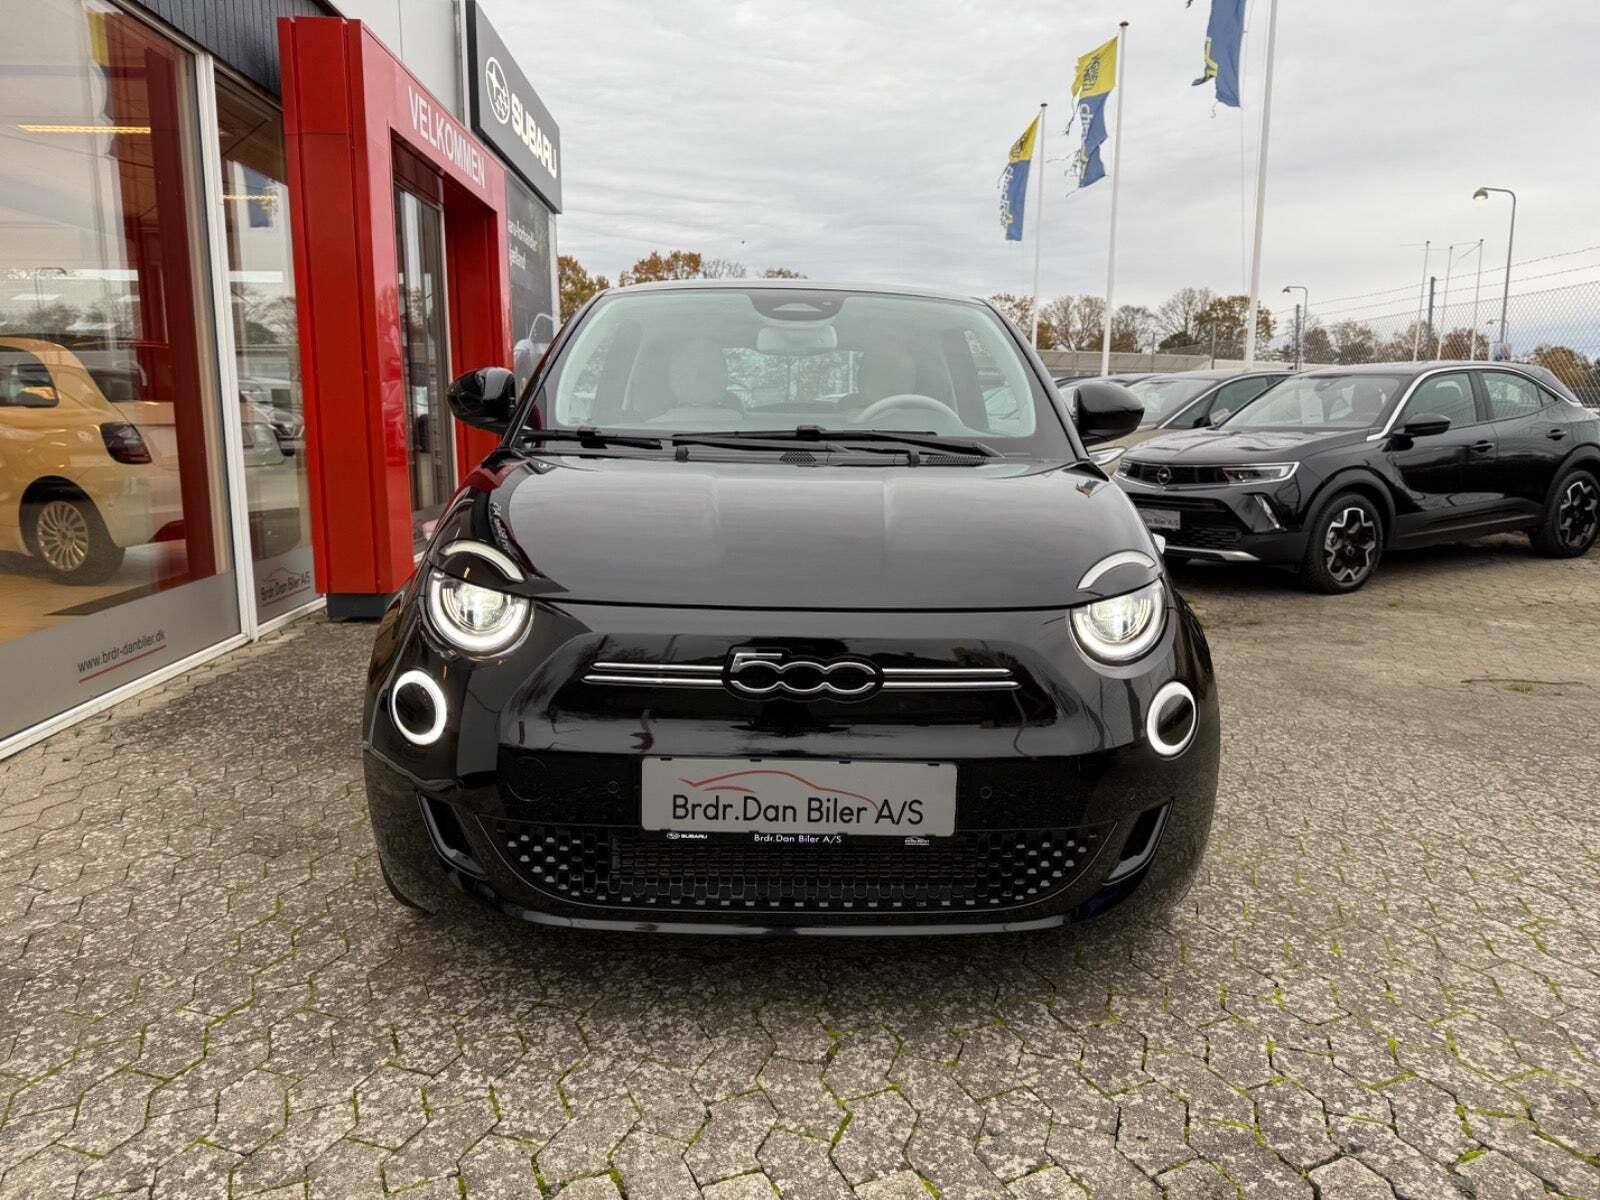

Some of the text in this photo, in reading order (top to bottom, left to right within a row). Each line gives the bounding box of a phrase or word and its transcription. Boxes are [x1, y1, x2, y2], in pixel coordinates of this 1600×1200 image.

[408, 85, 486, 190] VELKOMMEN
[511, 92, 558, 180] SUBARU
[77, 629, 166, 673] www.brdr-danbiler.dk
[729, 652, 877, 695] 500
[672, 794, 924, 825] Brdr.Dan Biler A/S
[754, 834, 842, 845] Brdr.Dan Biler A/S
